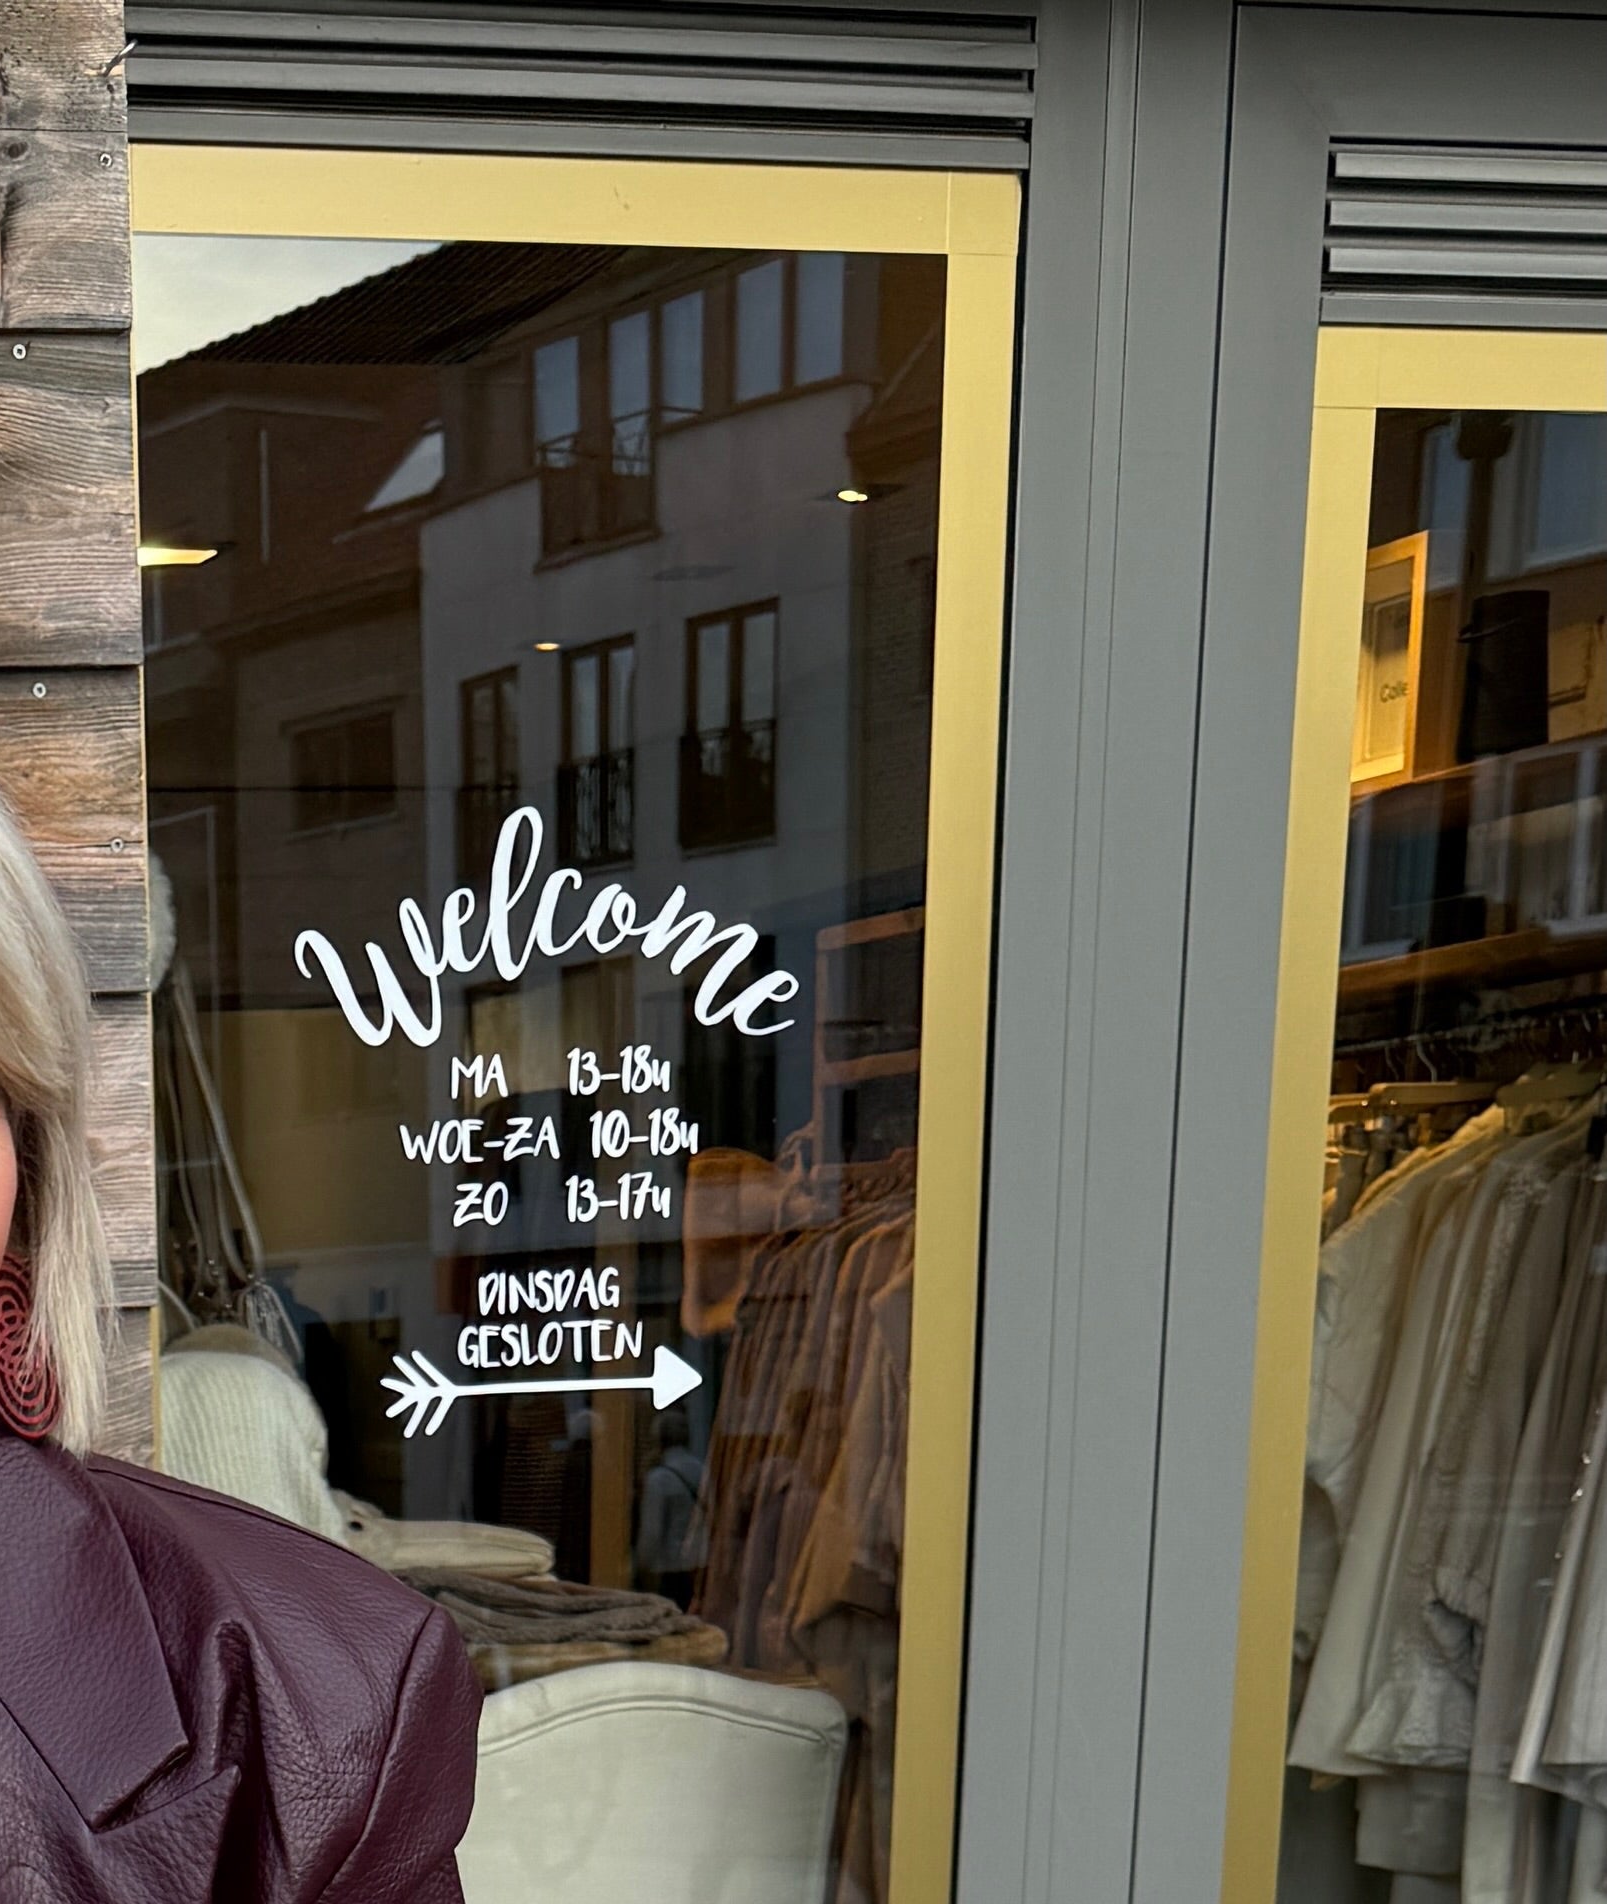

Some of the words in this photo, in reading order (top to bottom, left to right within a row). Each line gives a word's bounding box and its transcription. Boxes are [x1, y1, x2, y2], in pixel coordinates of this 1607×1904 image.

[294, 805, 800, 1048] Welcome
[450, 1053, 509, 1100] MA
[566, 1044, 671, 1096] 13-18u
[398, 1115, 561, 1165] WOE-ZA
[589, 1107, 699, 1159] 10-18u
[453, 1181, 509, 1228] ZO
[565, 1171, 671, 1223] 13-17u
[477, 1266, 620, 1316] DINSDAG
[456, 1318, 643, 1369] GESLOTEN
